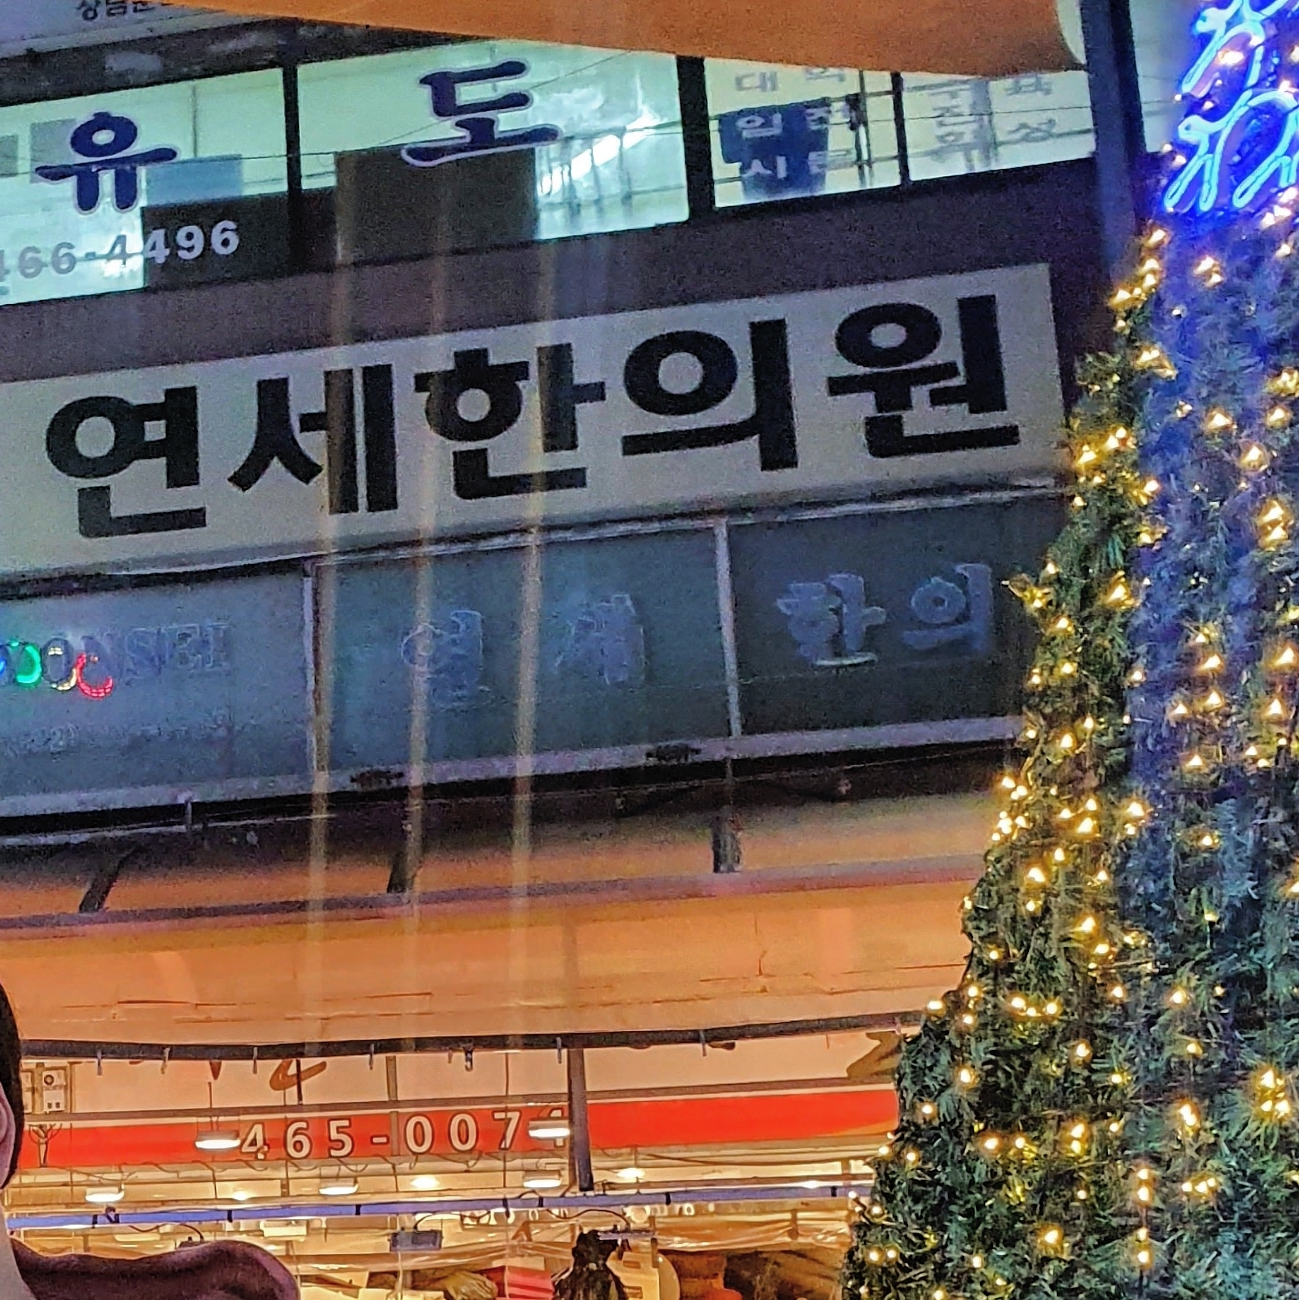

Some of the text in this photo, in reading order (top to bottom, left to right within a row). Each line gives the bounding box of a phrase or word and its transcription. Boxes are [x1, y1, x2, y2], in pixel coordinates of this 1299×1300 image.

[35, 58, 560, 214] 유 도
[45, 294, 1021, 540] 연세한의원
